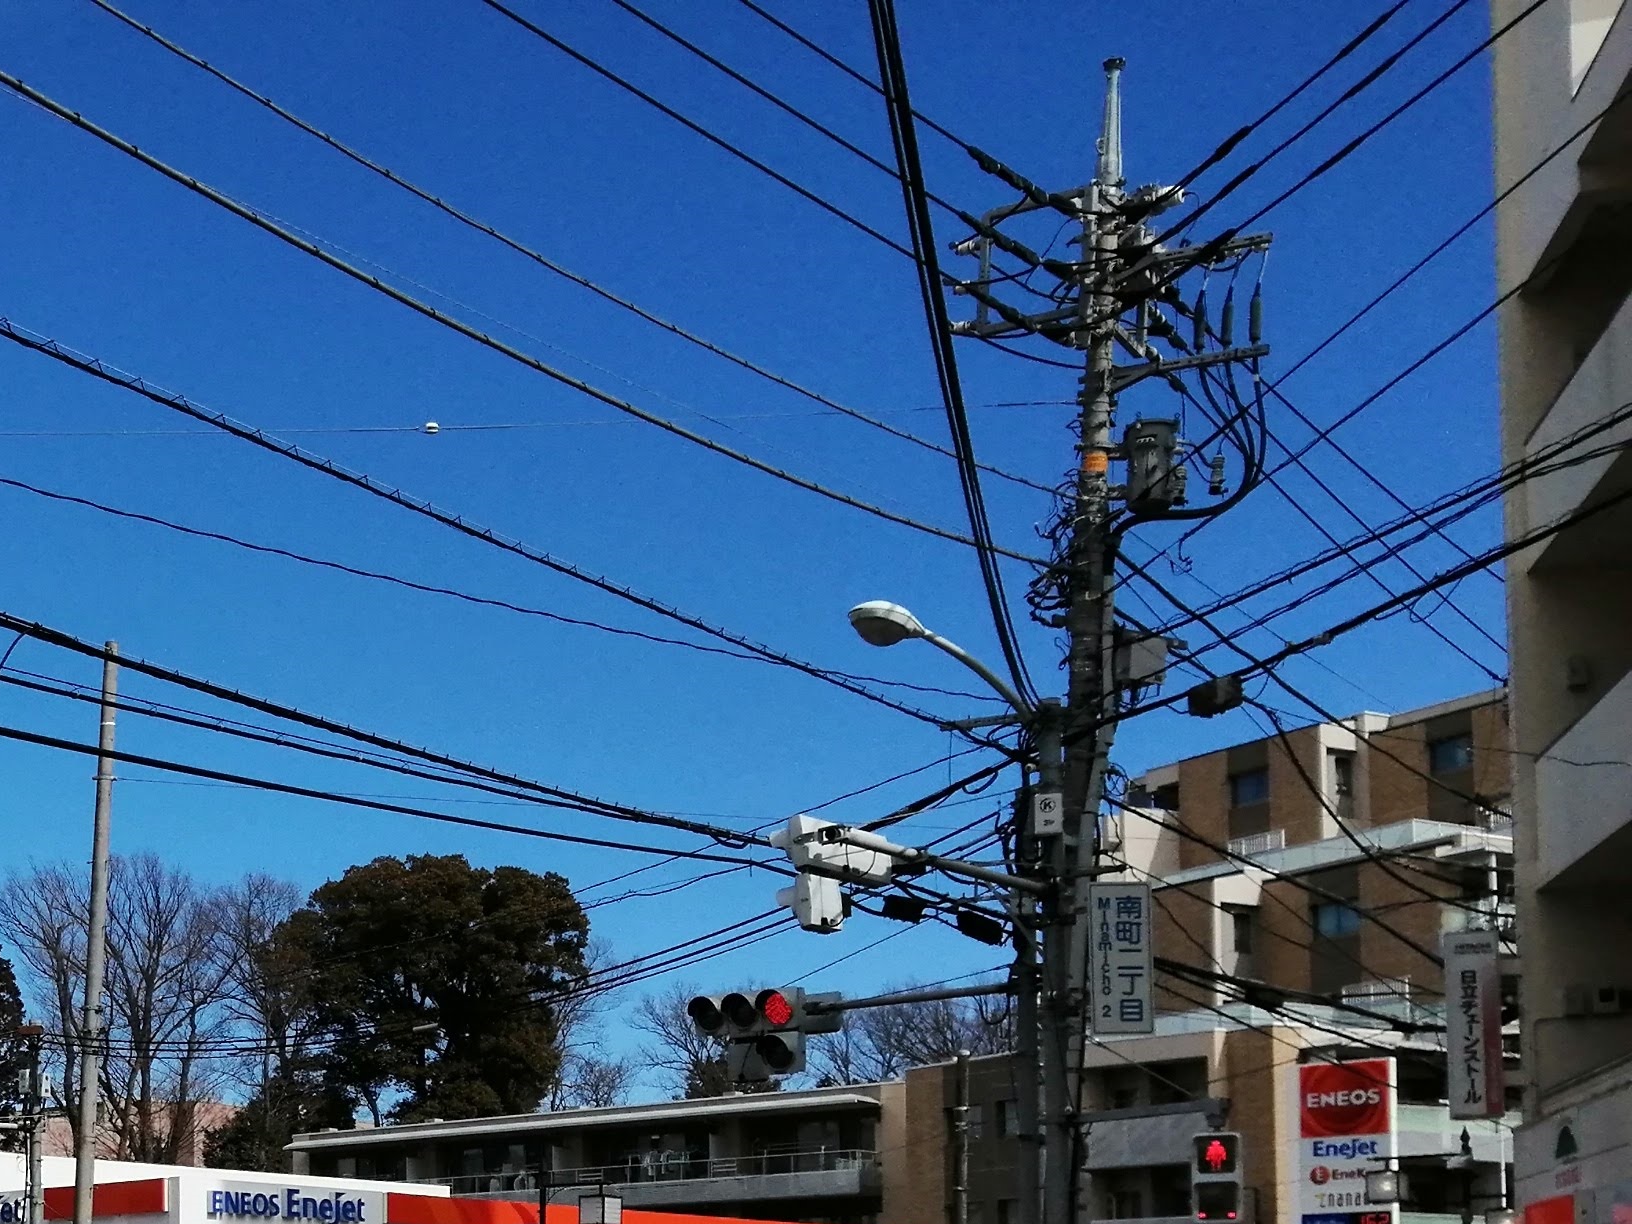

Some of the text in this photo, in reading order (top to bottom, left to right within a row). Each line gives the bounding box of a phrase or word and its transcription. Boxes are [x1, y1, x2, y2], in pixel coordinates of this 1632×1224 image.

[1097, 897, 1112, 1018] Minamicho 2
[1115, 895, 1144, 1022] 南町二丁目
[1461, 970, 1482, 1104] 日立チェーンストール
[1307, 1088, 1381, 1109] ENEOS
[212, 1190, 280, 1217] ENEOS
